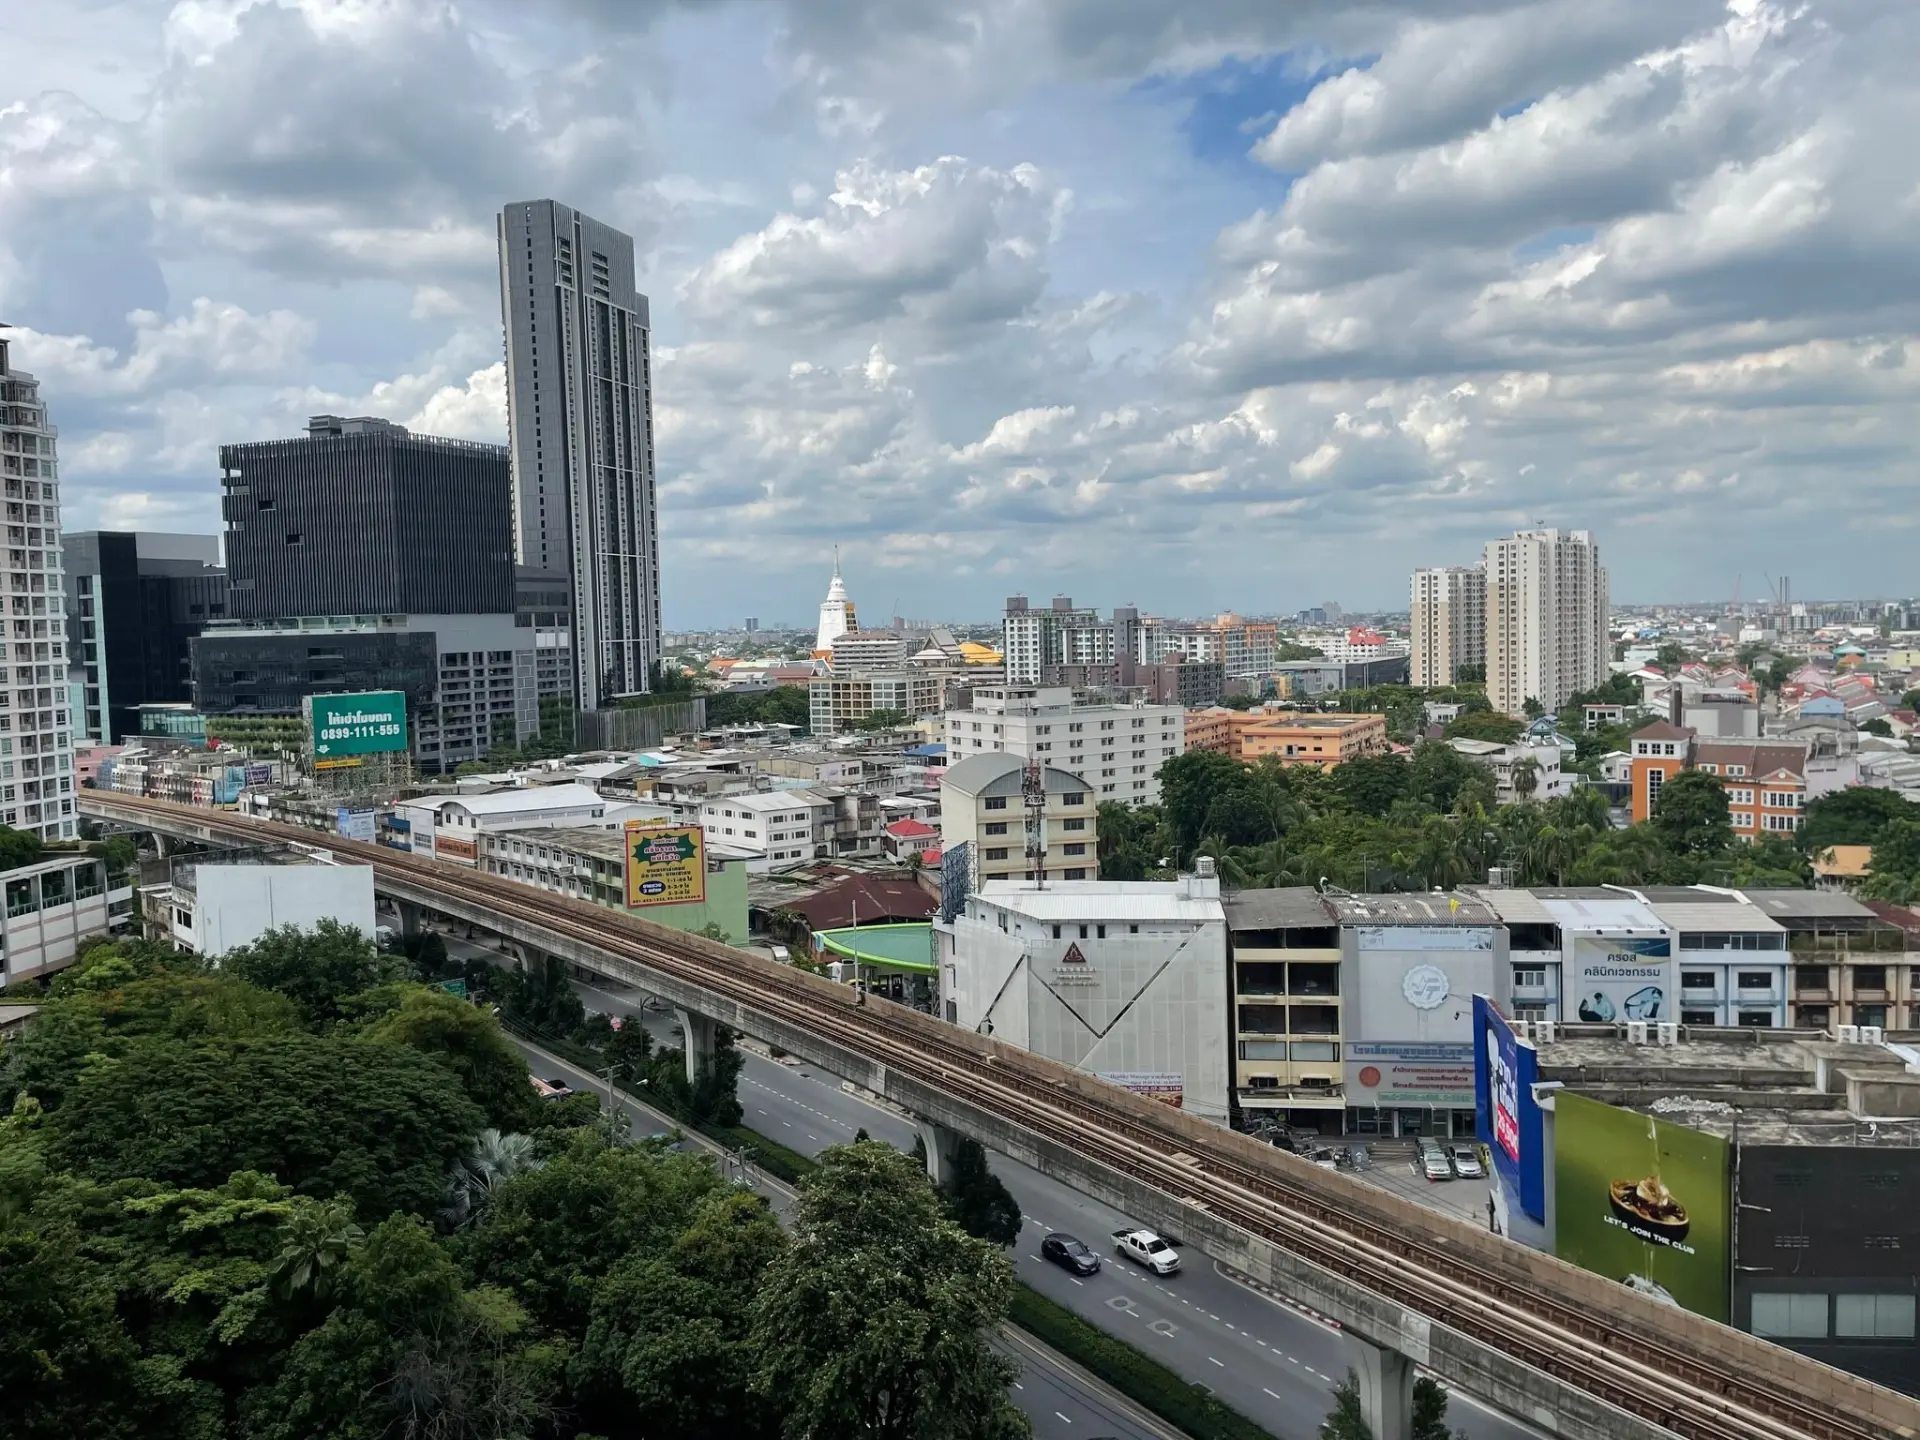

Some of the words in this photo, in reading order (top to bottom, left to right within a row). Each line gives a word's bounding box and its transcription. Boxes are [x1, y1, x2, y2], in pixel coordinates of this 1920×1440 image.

[327, 710, 392, 725] ให้เช่าโฆษณา
[321, 724, 399, 740] 0899-111-555
[1607, 953, 1637, 962] ครอส
[1584, 966, 1661, 977] คลินิกเวชกรรม
[1603, 1214, 1629, 1230] LET'S
[1630, 1226, 1652, 1239] JOIN
[1652, 1233, 1671, 1246] THE
[1672, 1241, 1696, 1255] CLUB
